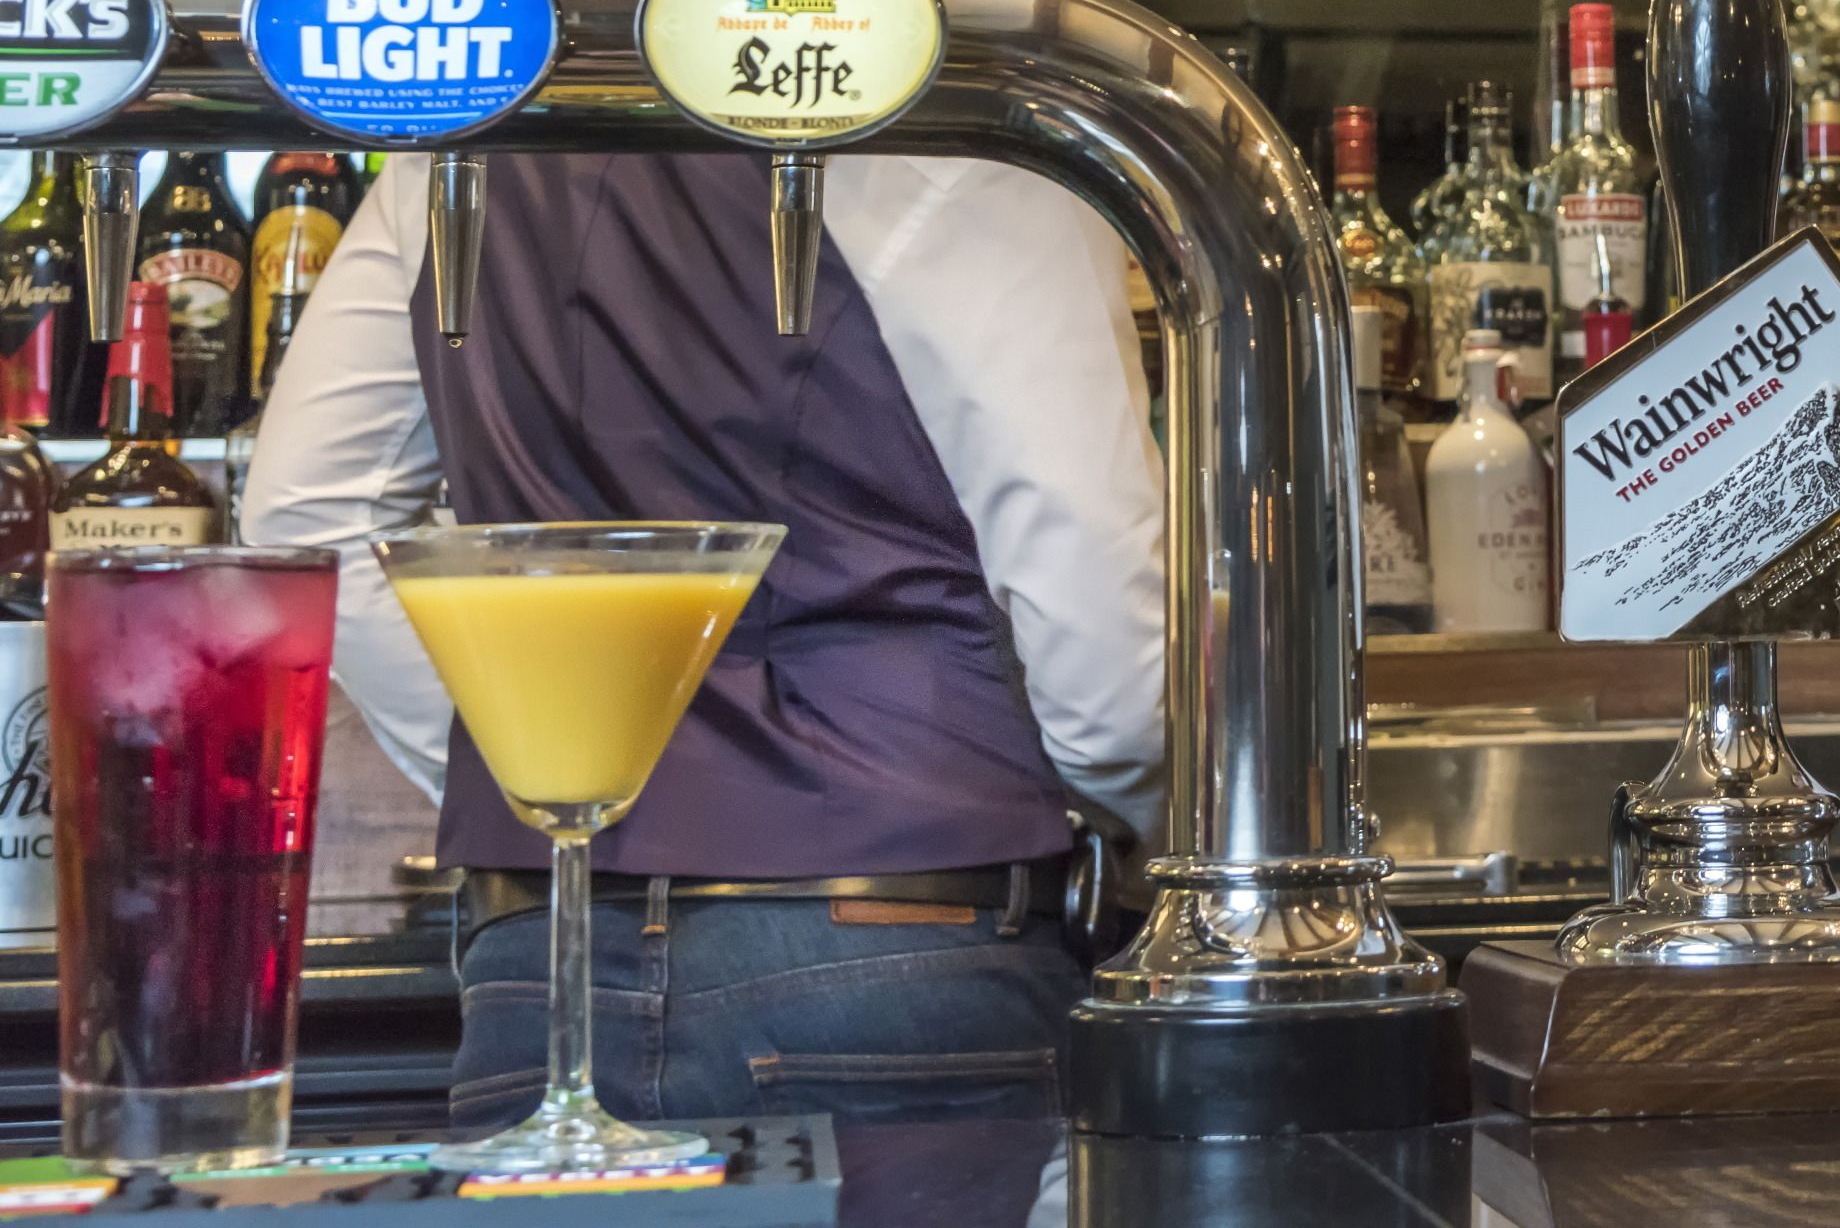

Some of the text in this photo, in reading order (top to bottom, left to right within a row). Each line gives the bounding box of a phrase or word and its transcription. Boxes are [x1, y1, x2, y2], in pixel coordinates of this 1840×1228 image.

[0, 71, 81, 107] ER
[727, 36, 853, 108] Leffe
[317, 97, 353, 108] BEST
[358, 99, 416, 109] BARLEY
[324, 86, 385, 98] BREWED
[437, 87, 464, 97] THE
[1573, 284, 1836, 482] Wainwright
[1616, 377, 1784, 502] THE GOLDEN BEER
[64, 519, 184, 539] Maker's
[1736, 544, 1814, 609] Refreshingly
[1769, 568, 1813, 607] crafted
[0, 834, 53, 859] UIC
